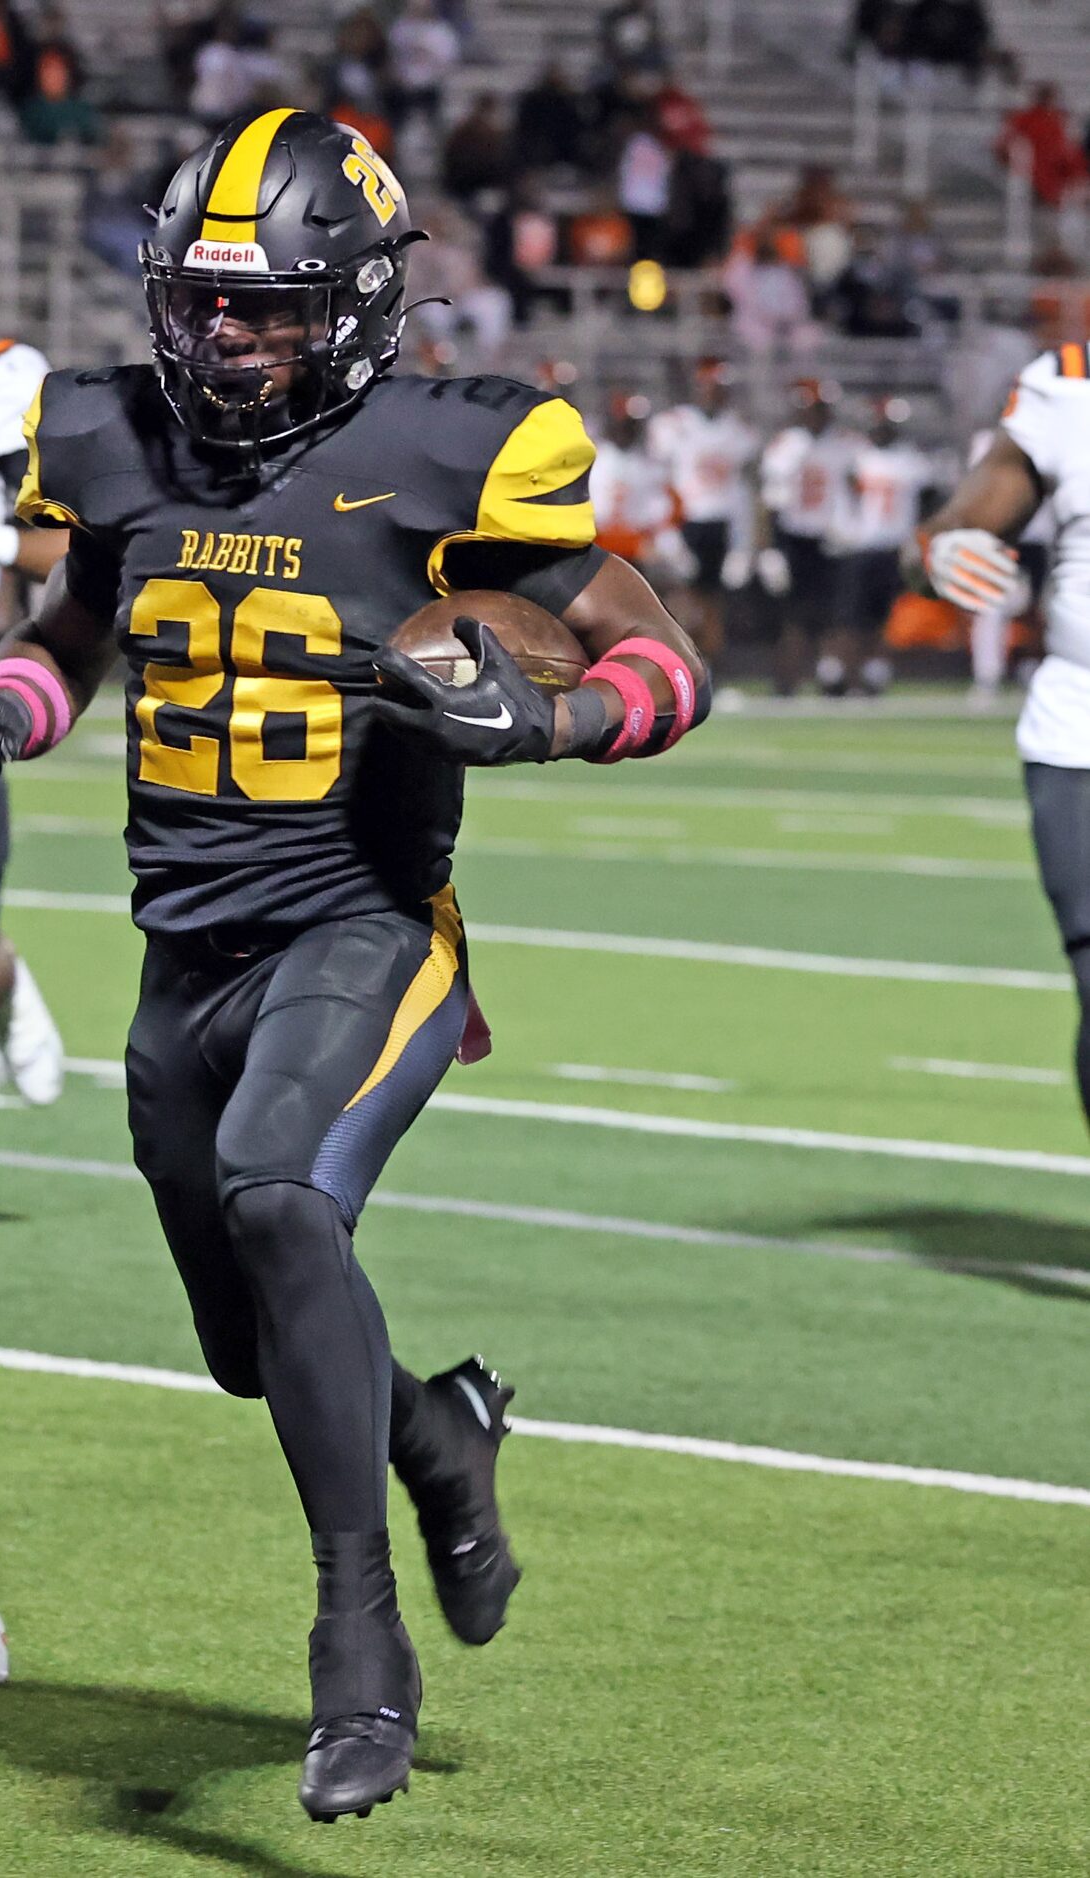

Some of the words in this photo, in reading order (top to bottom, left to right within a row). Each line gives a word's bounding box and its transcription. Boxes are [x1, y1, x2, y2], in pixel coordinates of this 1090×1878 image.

[194, 245, 254, 262] Riddell
[176, 530, 302, 578] RABBITS
[129, 578, 342, 800] 26
